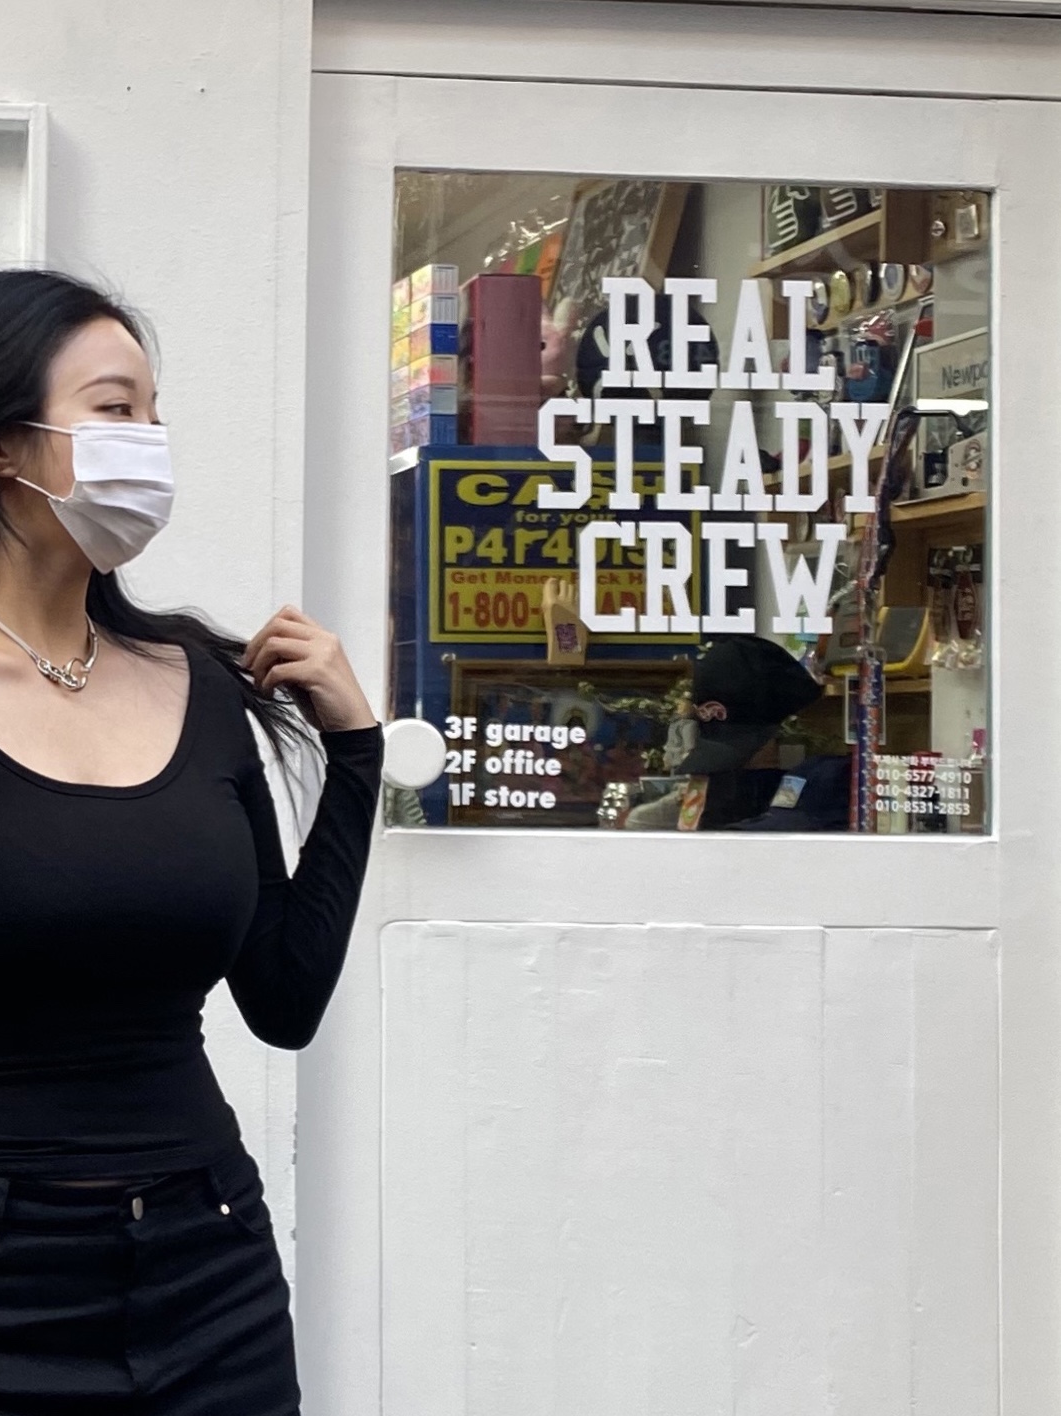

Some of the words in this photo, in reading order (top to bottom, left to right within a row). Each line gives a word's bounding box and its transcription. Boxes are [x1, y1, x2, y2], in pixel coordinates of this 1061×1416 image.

[601, 277, 835, 390] REAL
[537, 398, 890, 513] STEADY
[451, 571, 487, 584] Get
[579, 521, 847, 634] CREW
[444, 716, 478, 740] 3F
[485, 723, 587, 750] garage
[444, 749, 477, 774] 2F
[485, 749, 562, 776] office
[448, 782, 476, 807] 1F
[484, 785, 557, 809] store
